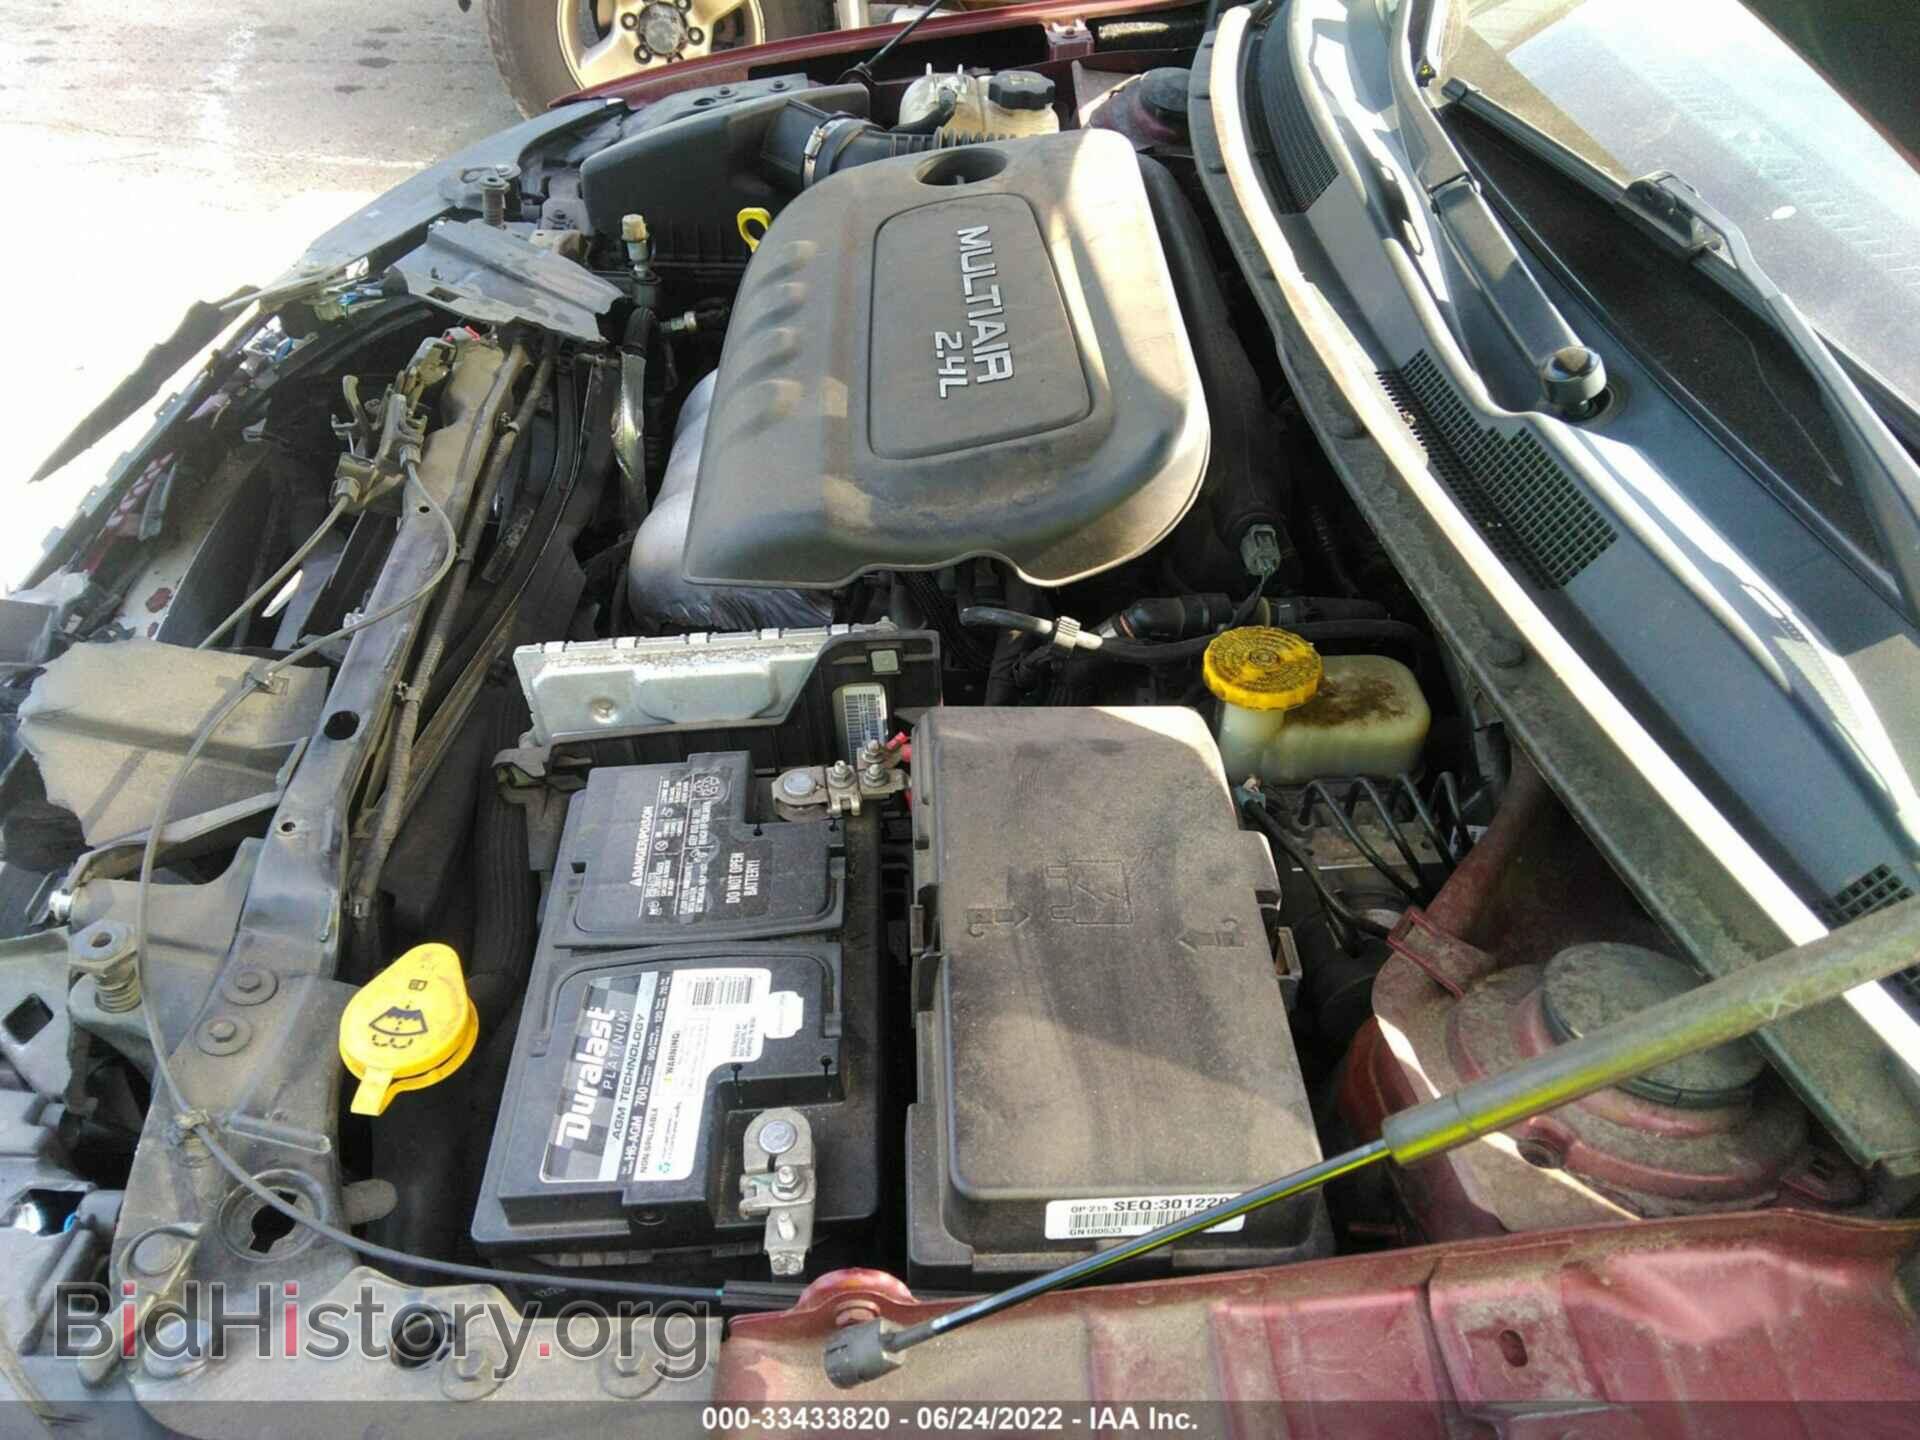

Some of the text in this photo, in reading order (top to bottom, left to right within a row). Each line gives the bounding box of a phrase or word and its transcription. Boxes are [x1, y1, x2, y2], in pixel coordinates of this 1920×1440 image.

[956, 225, 1015, 384] MULTIAIR
[934, 331, 969, 399] 2.4L
[726, 852, 744, 904] DO NOT OPEN
[744, 859, 760, 896] BATTERY!
[555, 1007, 615, 1146] Duralast
[602, 1008, 630, 1089] PLATINUM
[612, 1013, 645, 1140] AGM TECHNOLOGY
[624, 1115, 643, 1160] H6-AGM
[634, 1086, 649, 1107] 760
